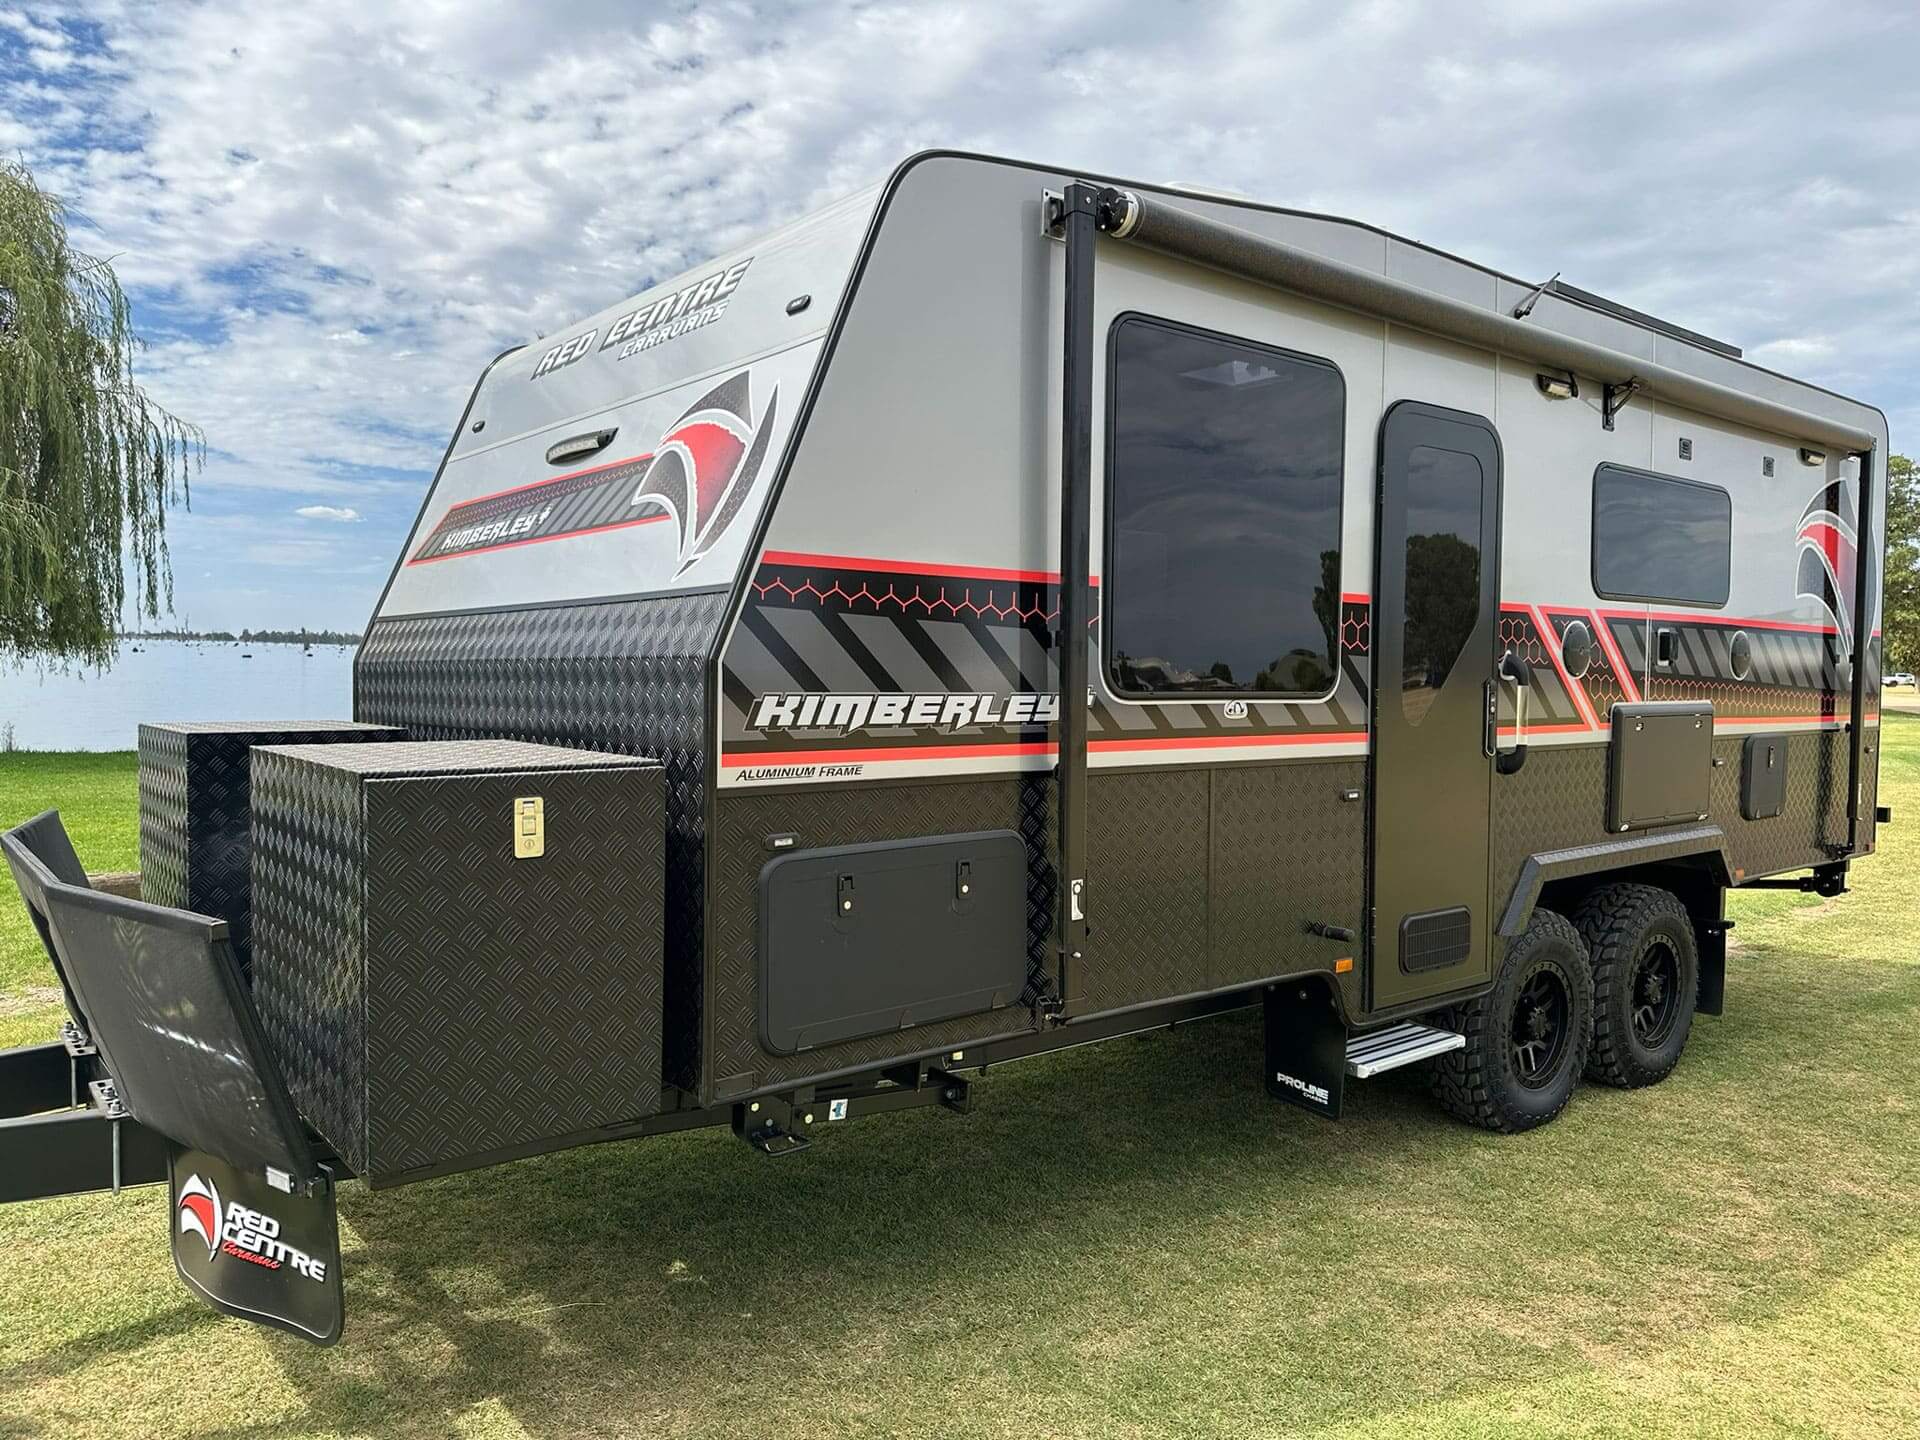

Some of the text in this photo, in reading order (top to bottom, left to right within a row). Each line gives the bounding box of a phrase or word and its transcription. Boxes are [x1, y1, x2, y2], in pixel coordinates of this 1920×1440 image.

[531, 256, 755, 380] RED CENTRE
[618, 300, 730, 360] CARAVANS
[441, 513, 538, 550] KIMBERLEY
[747, 692, 1059, 735] KIMBERLEY
[1276, 1072, 1329, 1100] PROLINE
[225, 1201, 280, 1239] RED
[222, 1221, 327, 1283] CENTRE
[222, 1240, 282, 1271] Caravans
